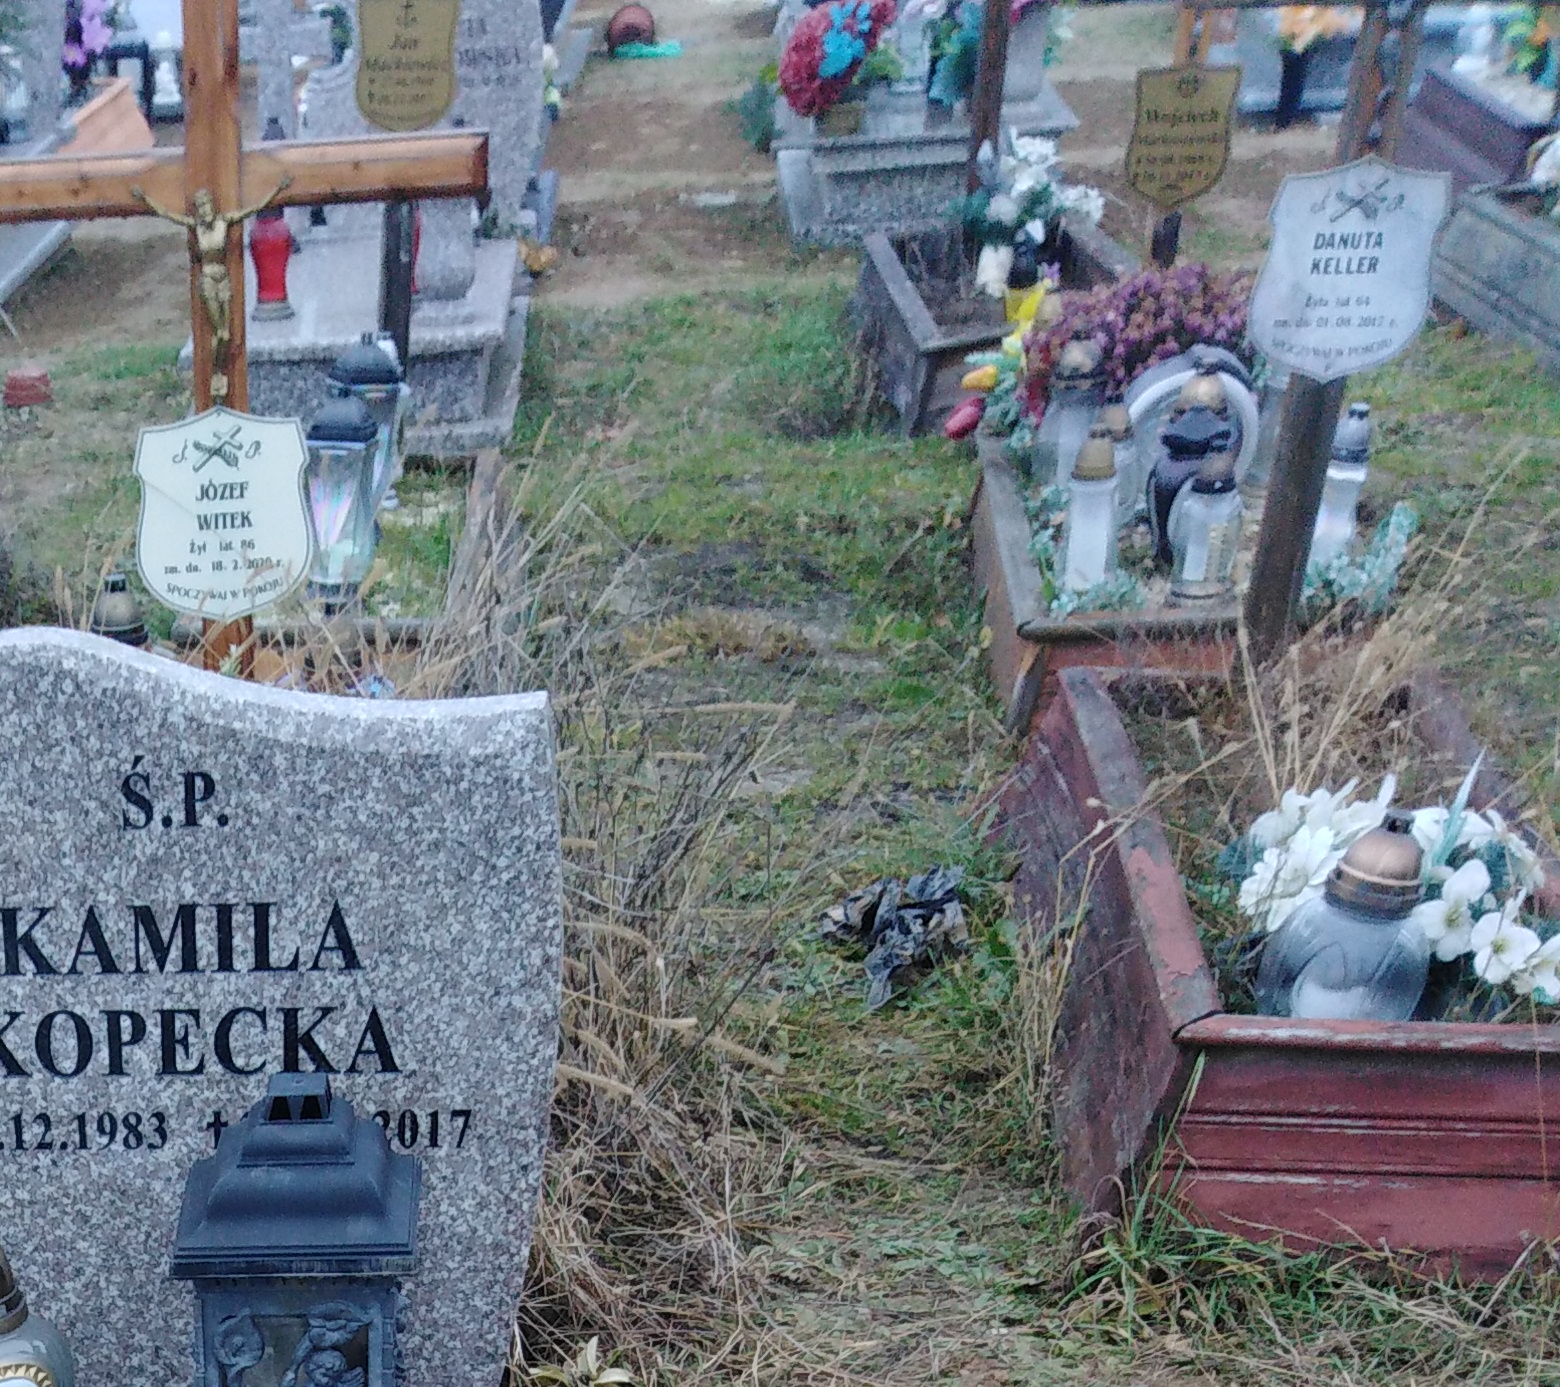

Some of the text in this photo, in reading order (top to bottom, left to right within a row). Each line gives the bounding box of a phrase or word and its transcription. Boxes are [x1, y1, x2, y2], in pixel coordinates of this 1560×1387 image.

[1313, 231, 1384, 250] DANUTA
[1309, 256, 1380, 275] KELLER
[195, 477, 250, 502] JÓZEF
[196, 511, 254, 531] WITEK
[219, 540, 235, 552] lat
[240, 539, 256, 551] 86
[121, 756, 230, 831] Ś.P.
